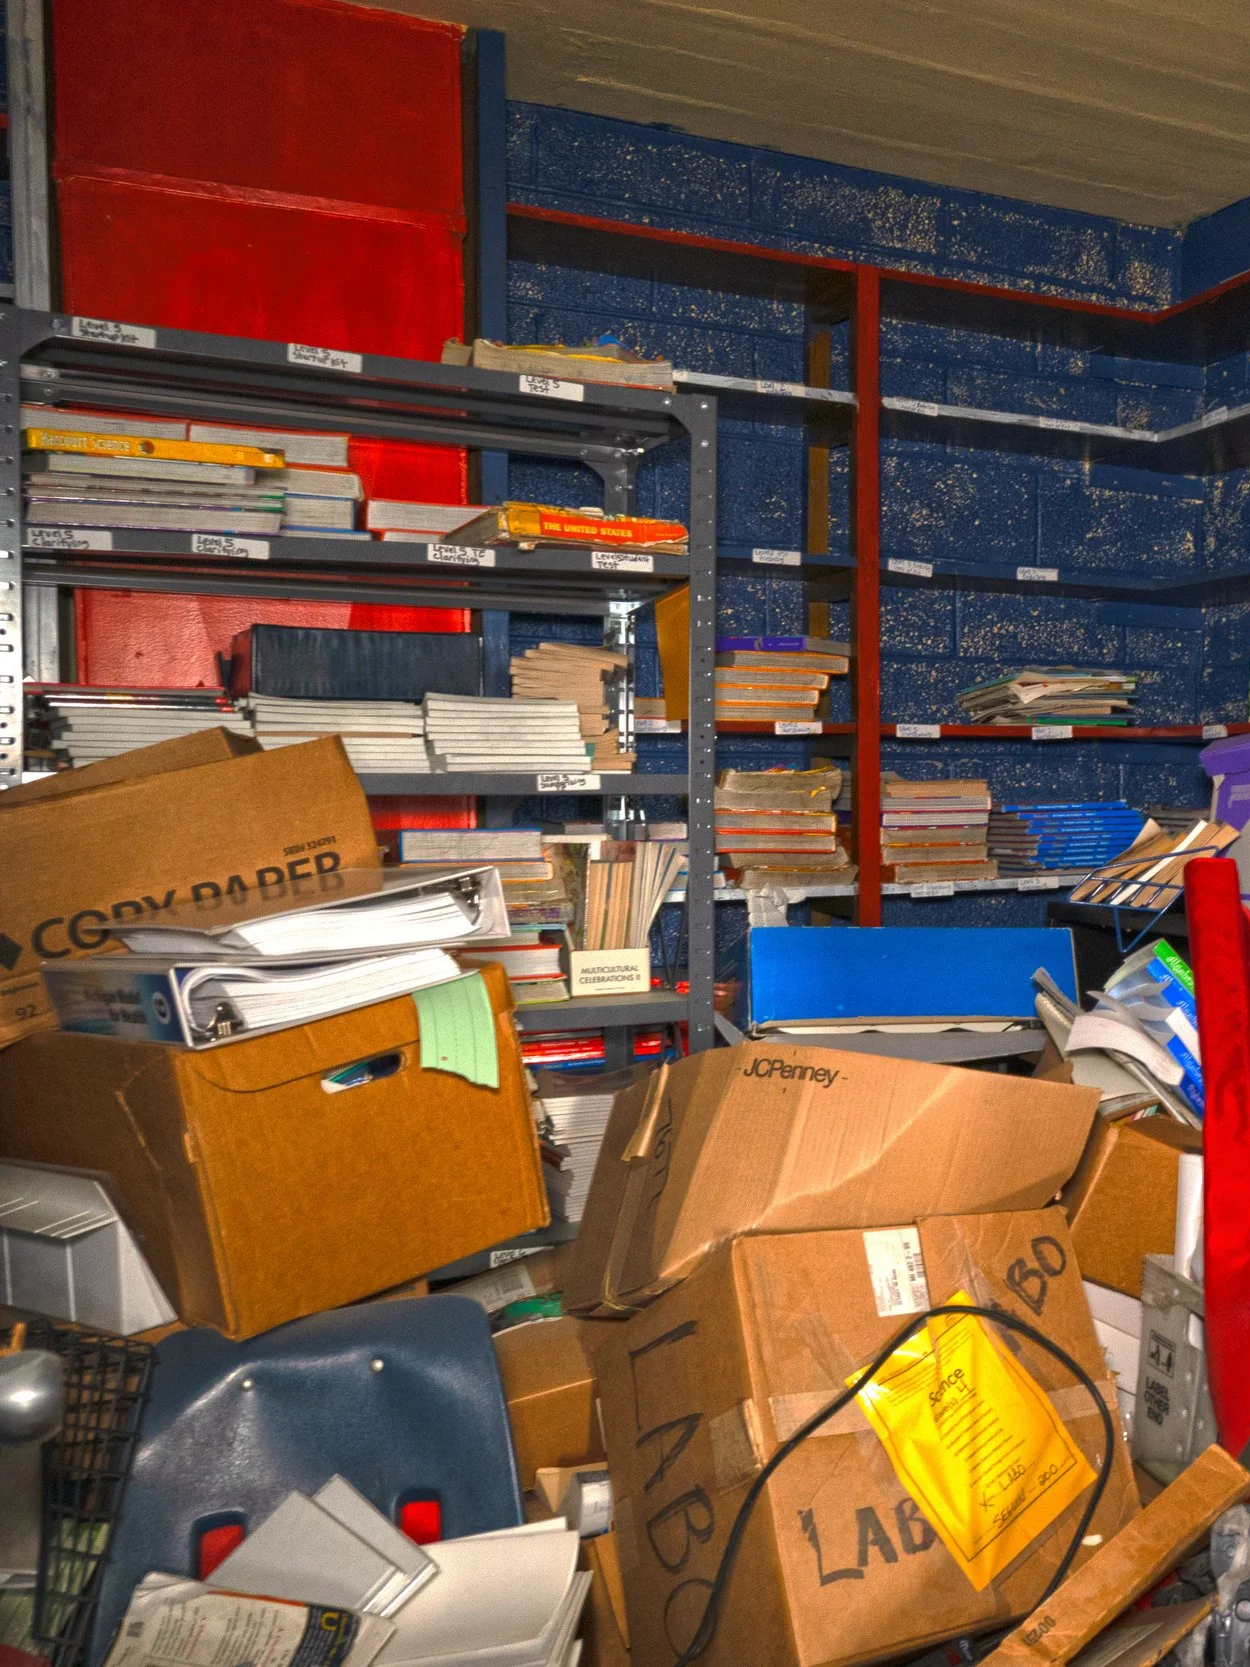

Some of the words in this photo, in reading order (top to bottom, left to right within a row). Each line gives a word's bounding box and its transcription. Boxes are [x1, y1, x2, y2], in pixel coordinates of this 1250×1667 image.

[543, 521, 562, 532] THE
[564, 523, 598, 535] UNITED
[600, 527, 633, 538] STATES
[579, 975, 634, 985] CELEBRATIONS
[580, 965, 640, 975] MULTICULTURAL
[743, 1057, 841, 1089] JCPenney
[927, 1366, 966, 1408] Scence
[1146, 1376, 1169, 1401] LABEL
[1144, 1390, 1171, 1416] OTHER
[1147, 1406, 1163, 1426] END
